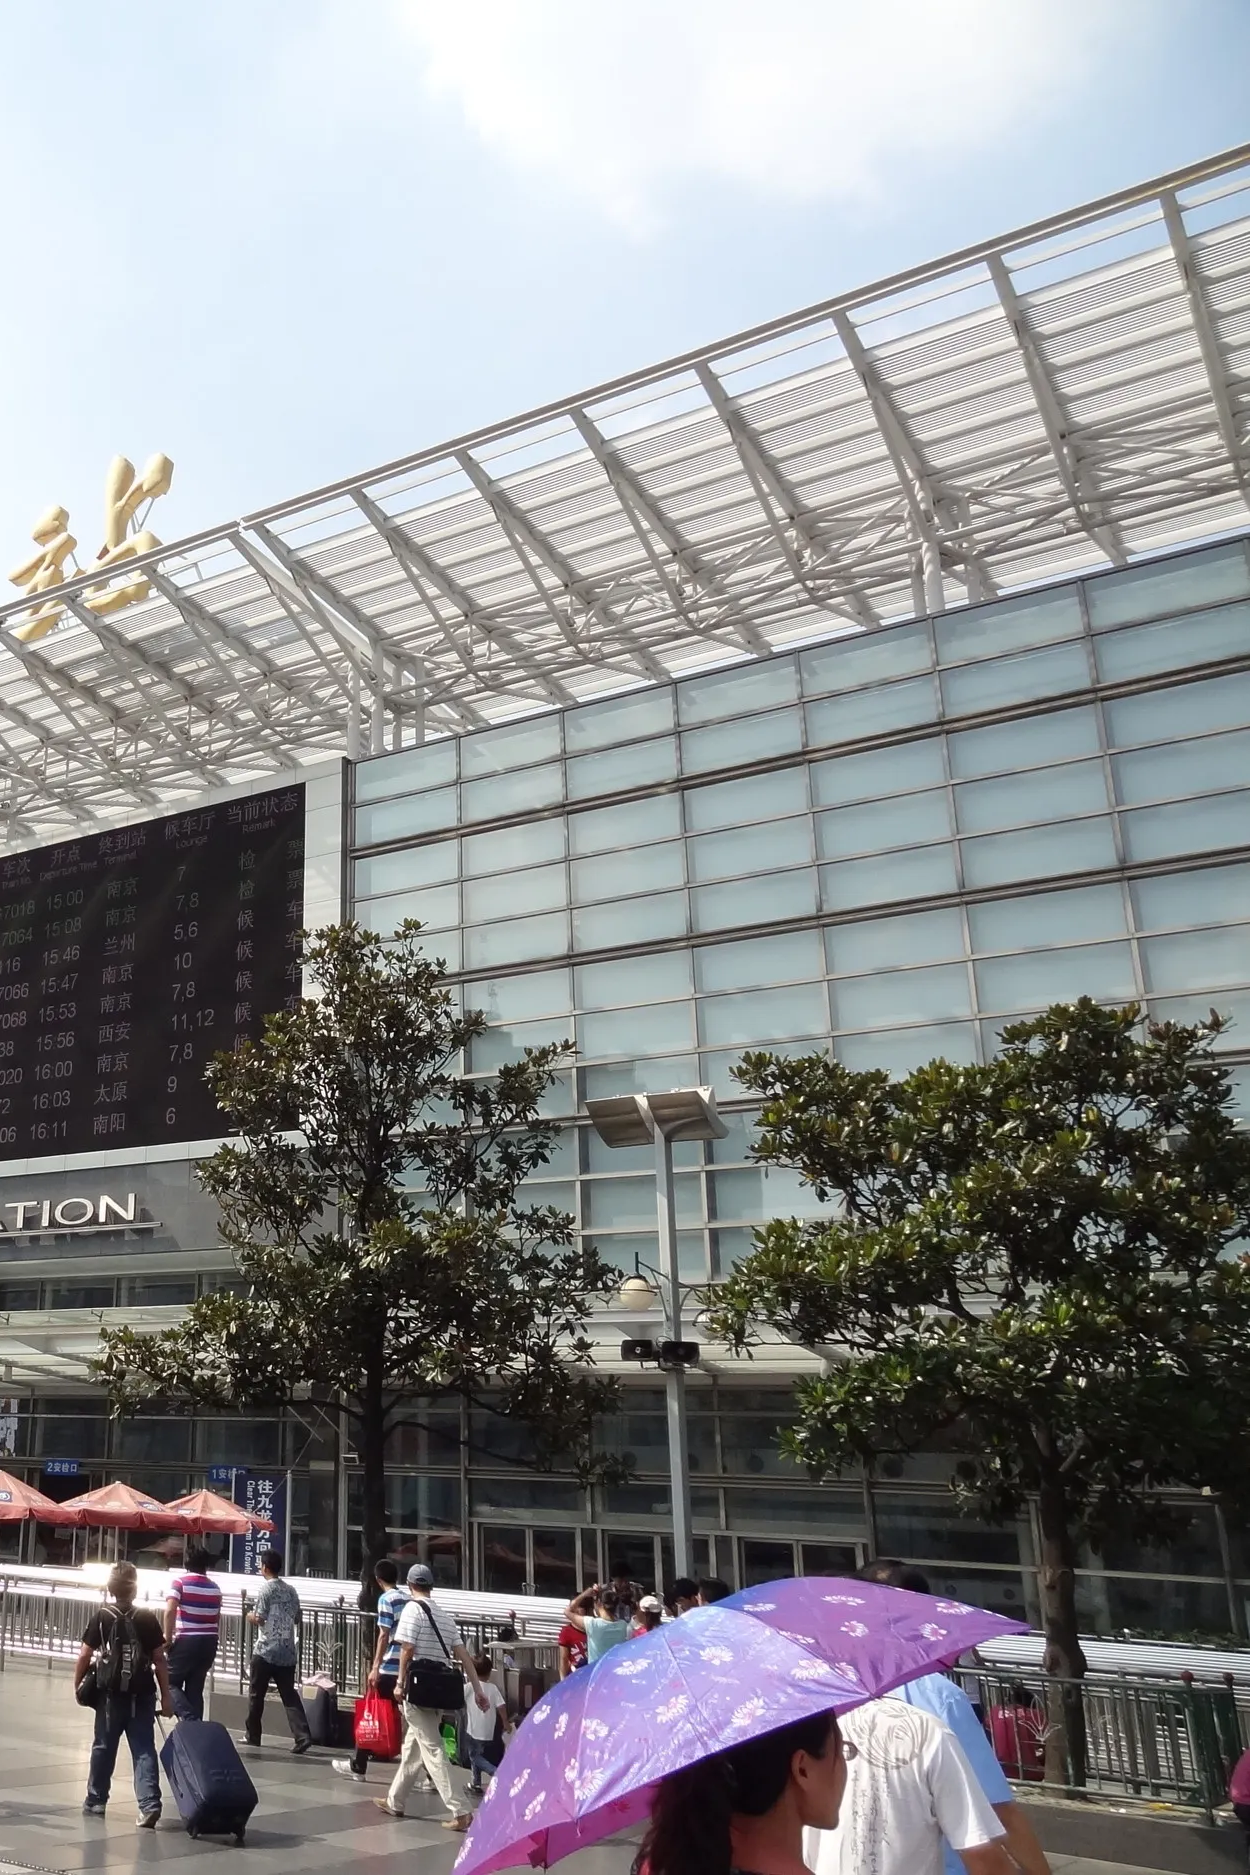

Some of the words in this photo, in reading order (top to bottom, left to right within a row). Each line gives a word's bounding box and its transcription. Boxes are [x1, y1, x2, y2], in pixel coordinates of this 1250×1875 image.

[2, 857, 31, 878] 车次
[51, 846, 81, 868] 开点
[99, 829, 146, 855] 终到站
[165, 811, 216, 840] 候车厅
[226, 792, 298, 825] 当前状态
[176, 835, 208, 849] Lounge
[242, 819, 275, 834] Remark
[47, 889, 84, 911] 15:00
[107, 876, 139, 899] 南京
[177, 866, 186, 882] 7
[44, 917, 82, 939] 15:08
[105, 905, 137, 927] 南京
[42, 945, 81, 966] 15:46
[103, 932, 136, 956] 兰州
[41, 973, 79, 995] 15:47
[102, 963, 134, 985] 南京
[174, 951, 192, 970] 10
[39, 1002, 77, 1023] 15:53
[101, 992, 133, 1014] 南京
[172, 981, 196, 1002] 7,8
[37, 1031, 75, 1051] 15:56
[99, 1021, 132, 1044] 西安
[171, 1008, 215, 1031] 11,12
[34, 1060, 73, 1081] 16:00
[97, 1051, 130, 1074] 南京
[169, 1042, 193, 1063] 7,8
[32, 1090, 71, 1110] 16:03
[94, 1080, 128, 1105] 太原
[167, 1076, 177, 1093] 9
[30, 1120, 68, 1140] 16:11
[93, 1112, 126, 1135] 南阳
[166, 1107, 176, 1125] 6
[47, 1462, 77, 1472] 2安检口
[245, 1542, 253, 1550] To
